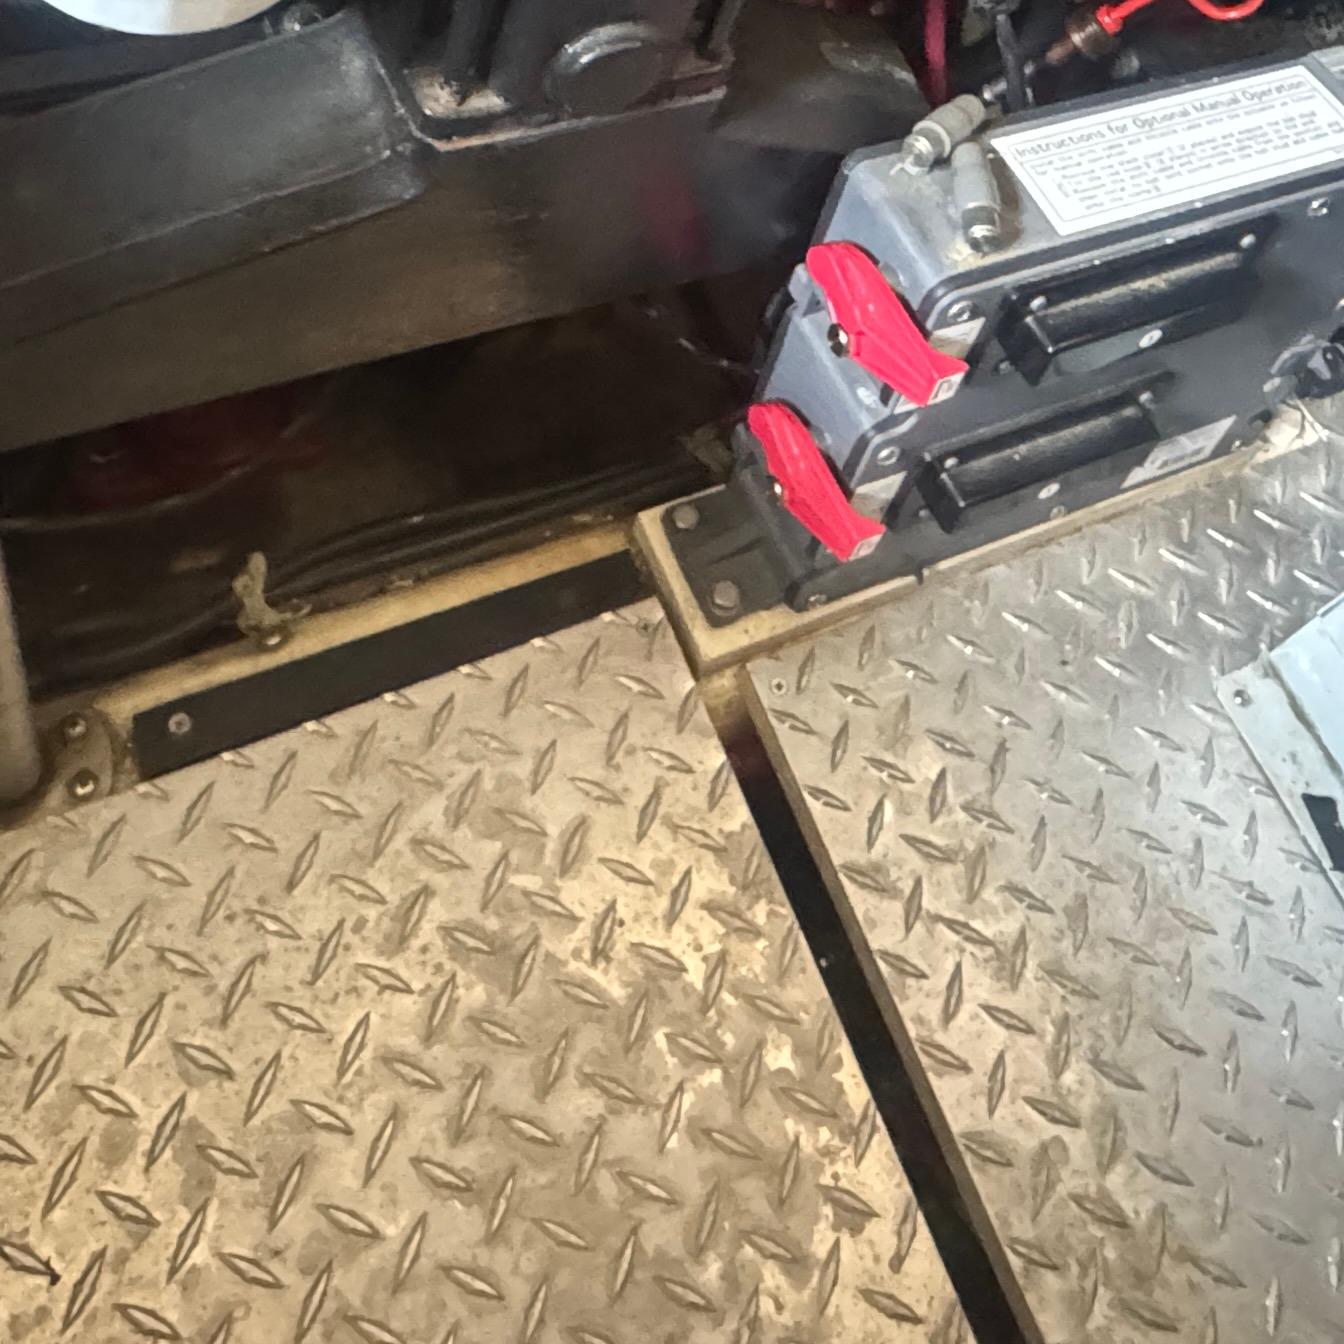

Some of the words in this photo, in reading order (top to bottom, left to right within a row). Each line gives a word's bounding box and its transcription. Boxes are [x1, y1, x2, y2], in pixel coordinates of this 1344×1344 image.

[1015, 128, 1107, 157] Instructions
[1107, 123, 1130, 136] for
[1131, 107, 1192, 130] Optional
[1191, 93, 1242, 113] Manual
[1240, 78, 1309, 103] Operation
